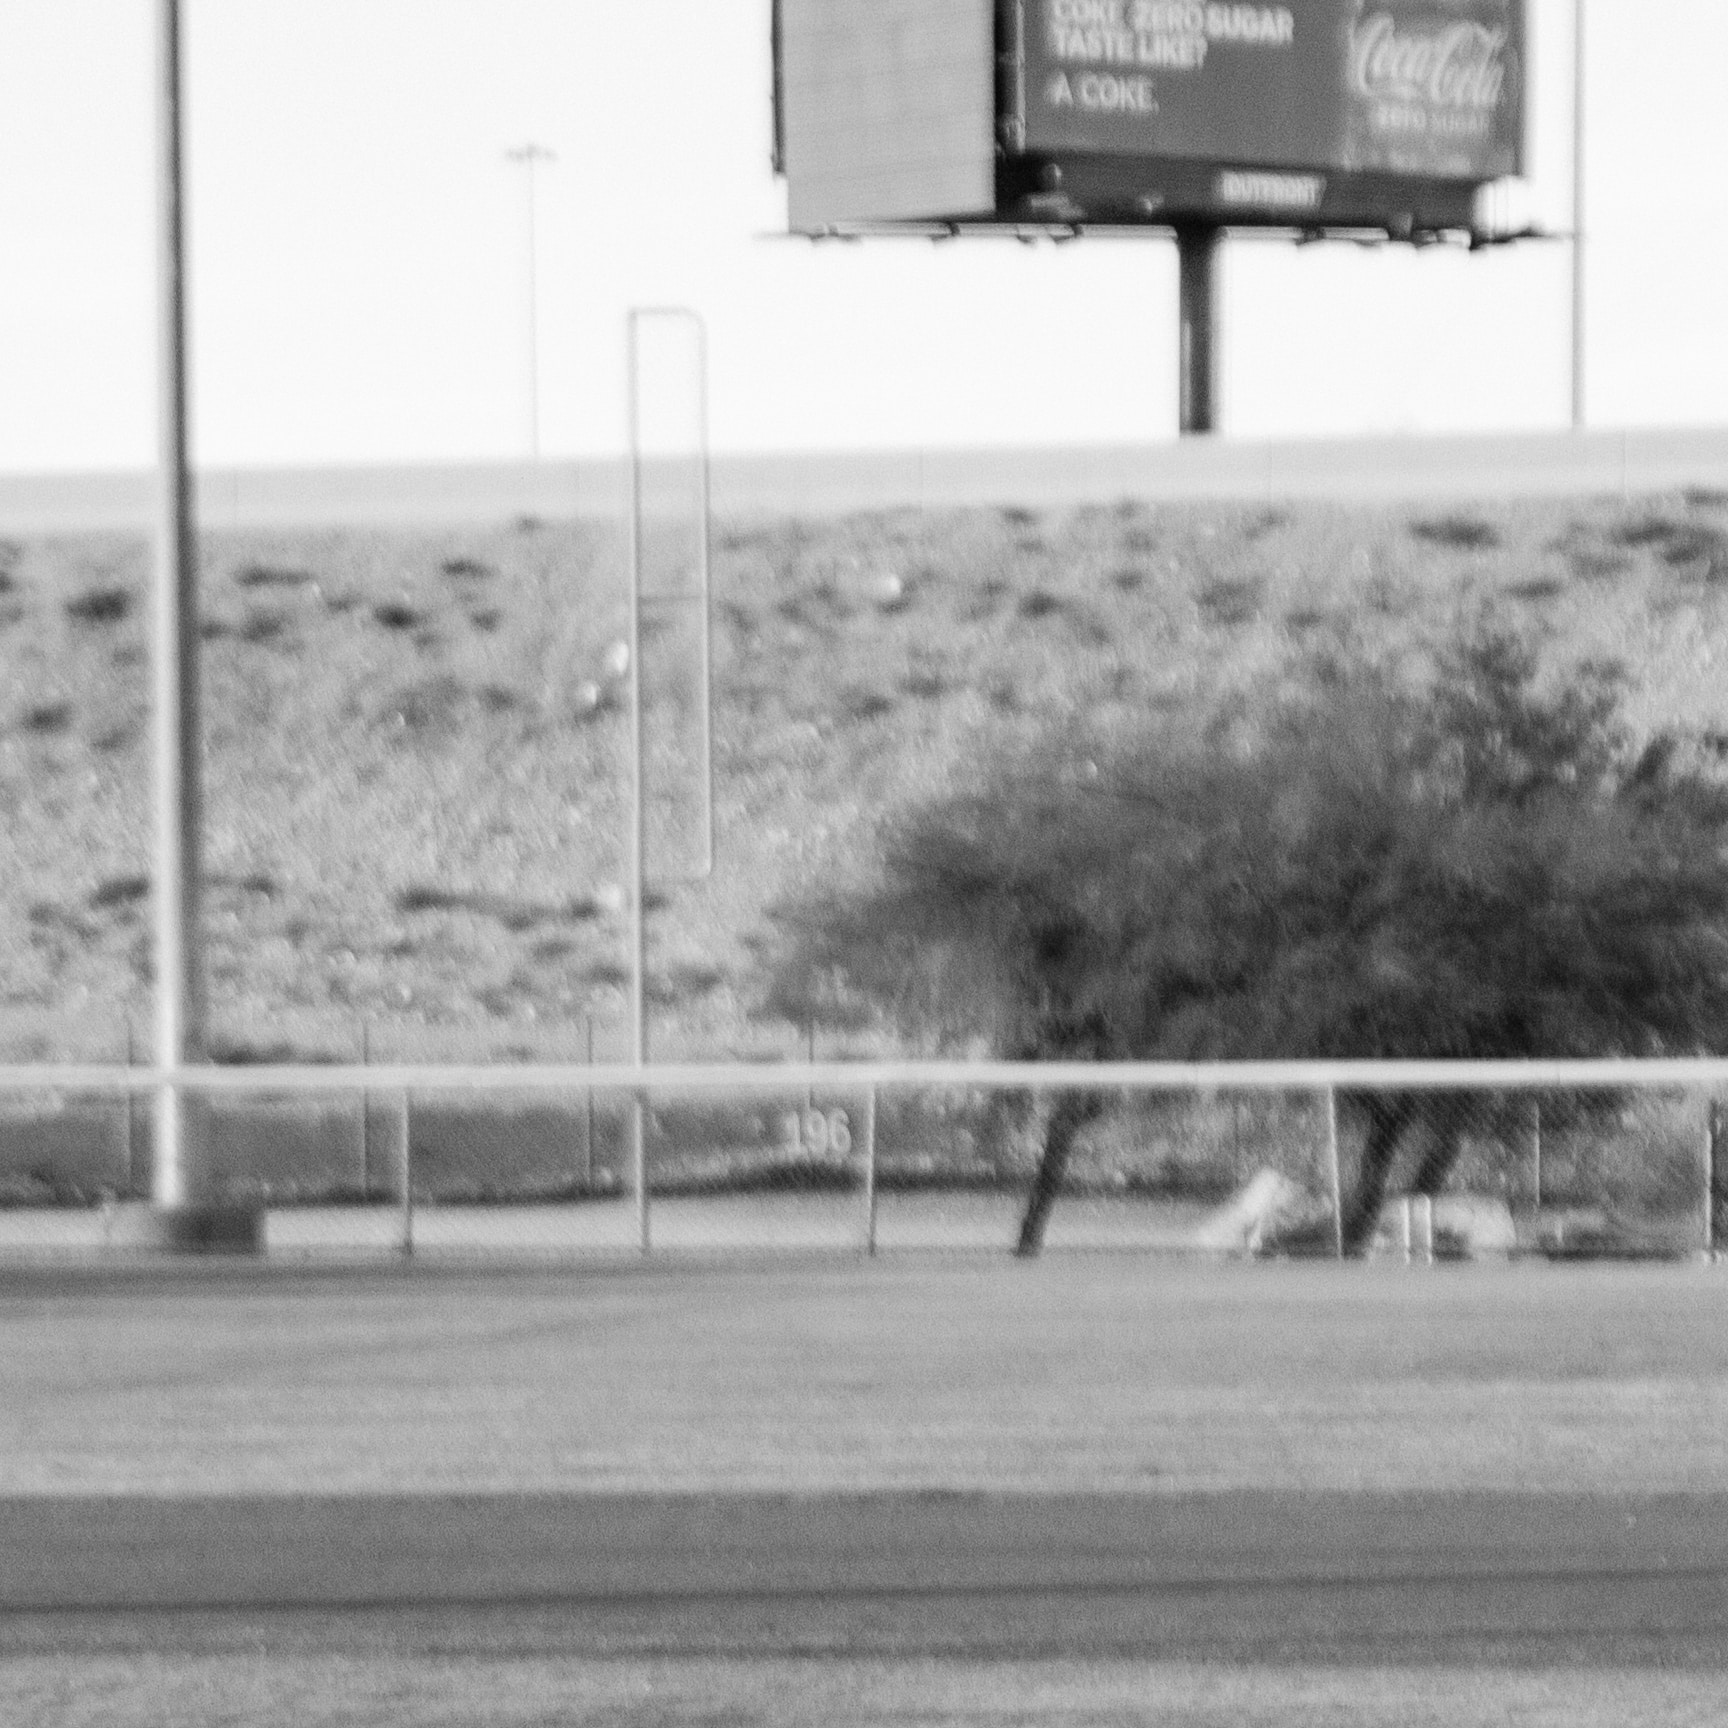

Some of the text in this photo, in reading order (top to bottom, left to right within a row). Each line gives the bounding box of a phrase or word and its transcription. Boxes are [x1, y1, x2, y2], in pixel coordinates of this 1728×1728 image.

[1206, 3, 1295, 43] SUGAR
[1052, 26, 1134, 61] TASTE
[1046, 70, 1074, 108] A
[782, 1107, 852, 1155] 196
